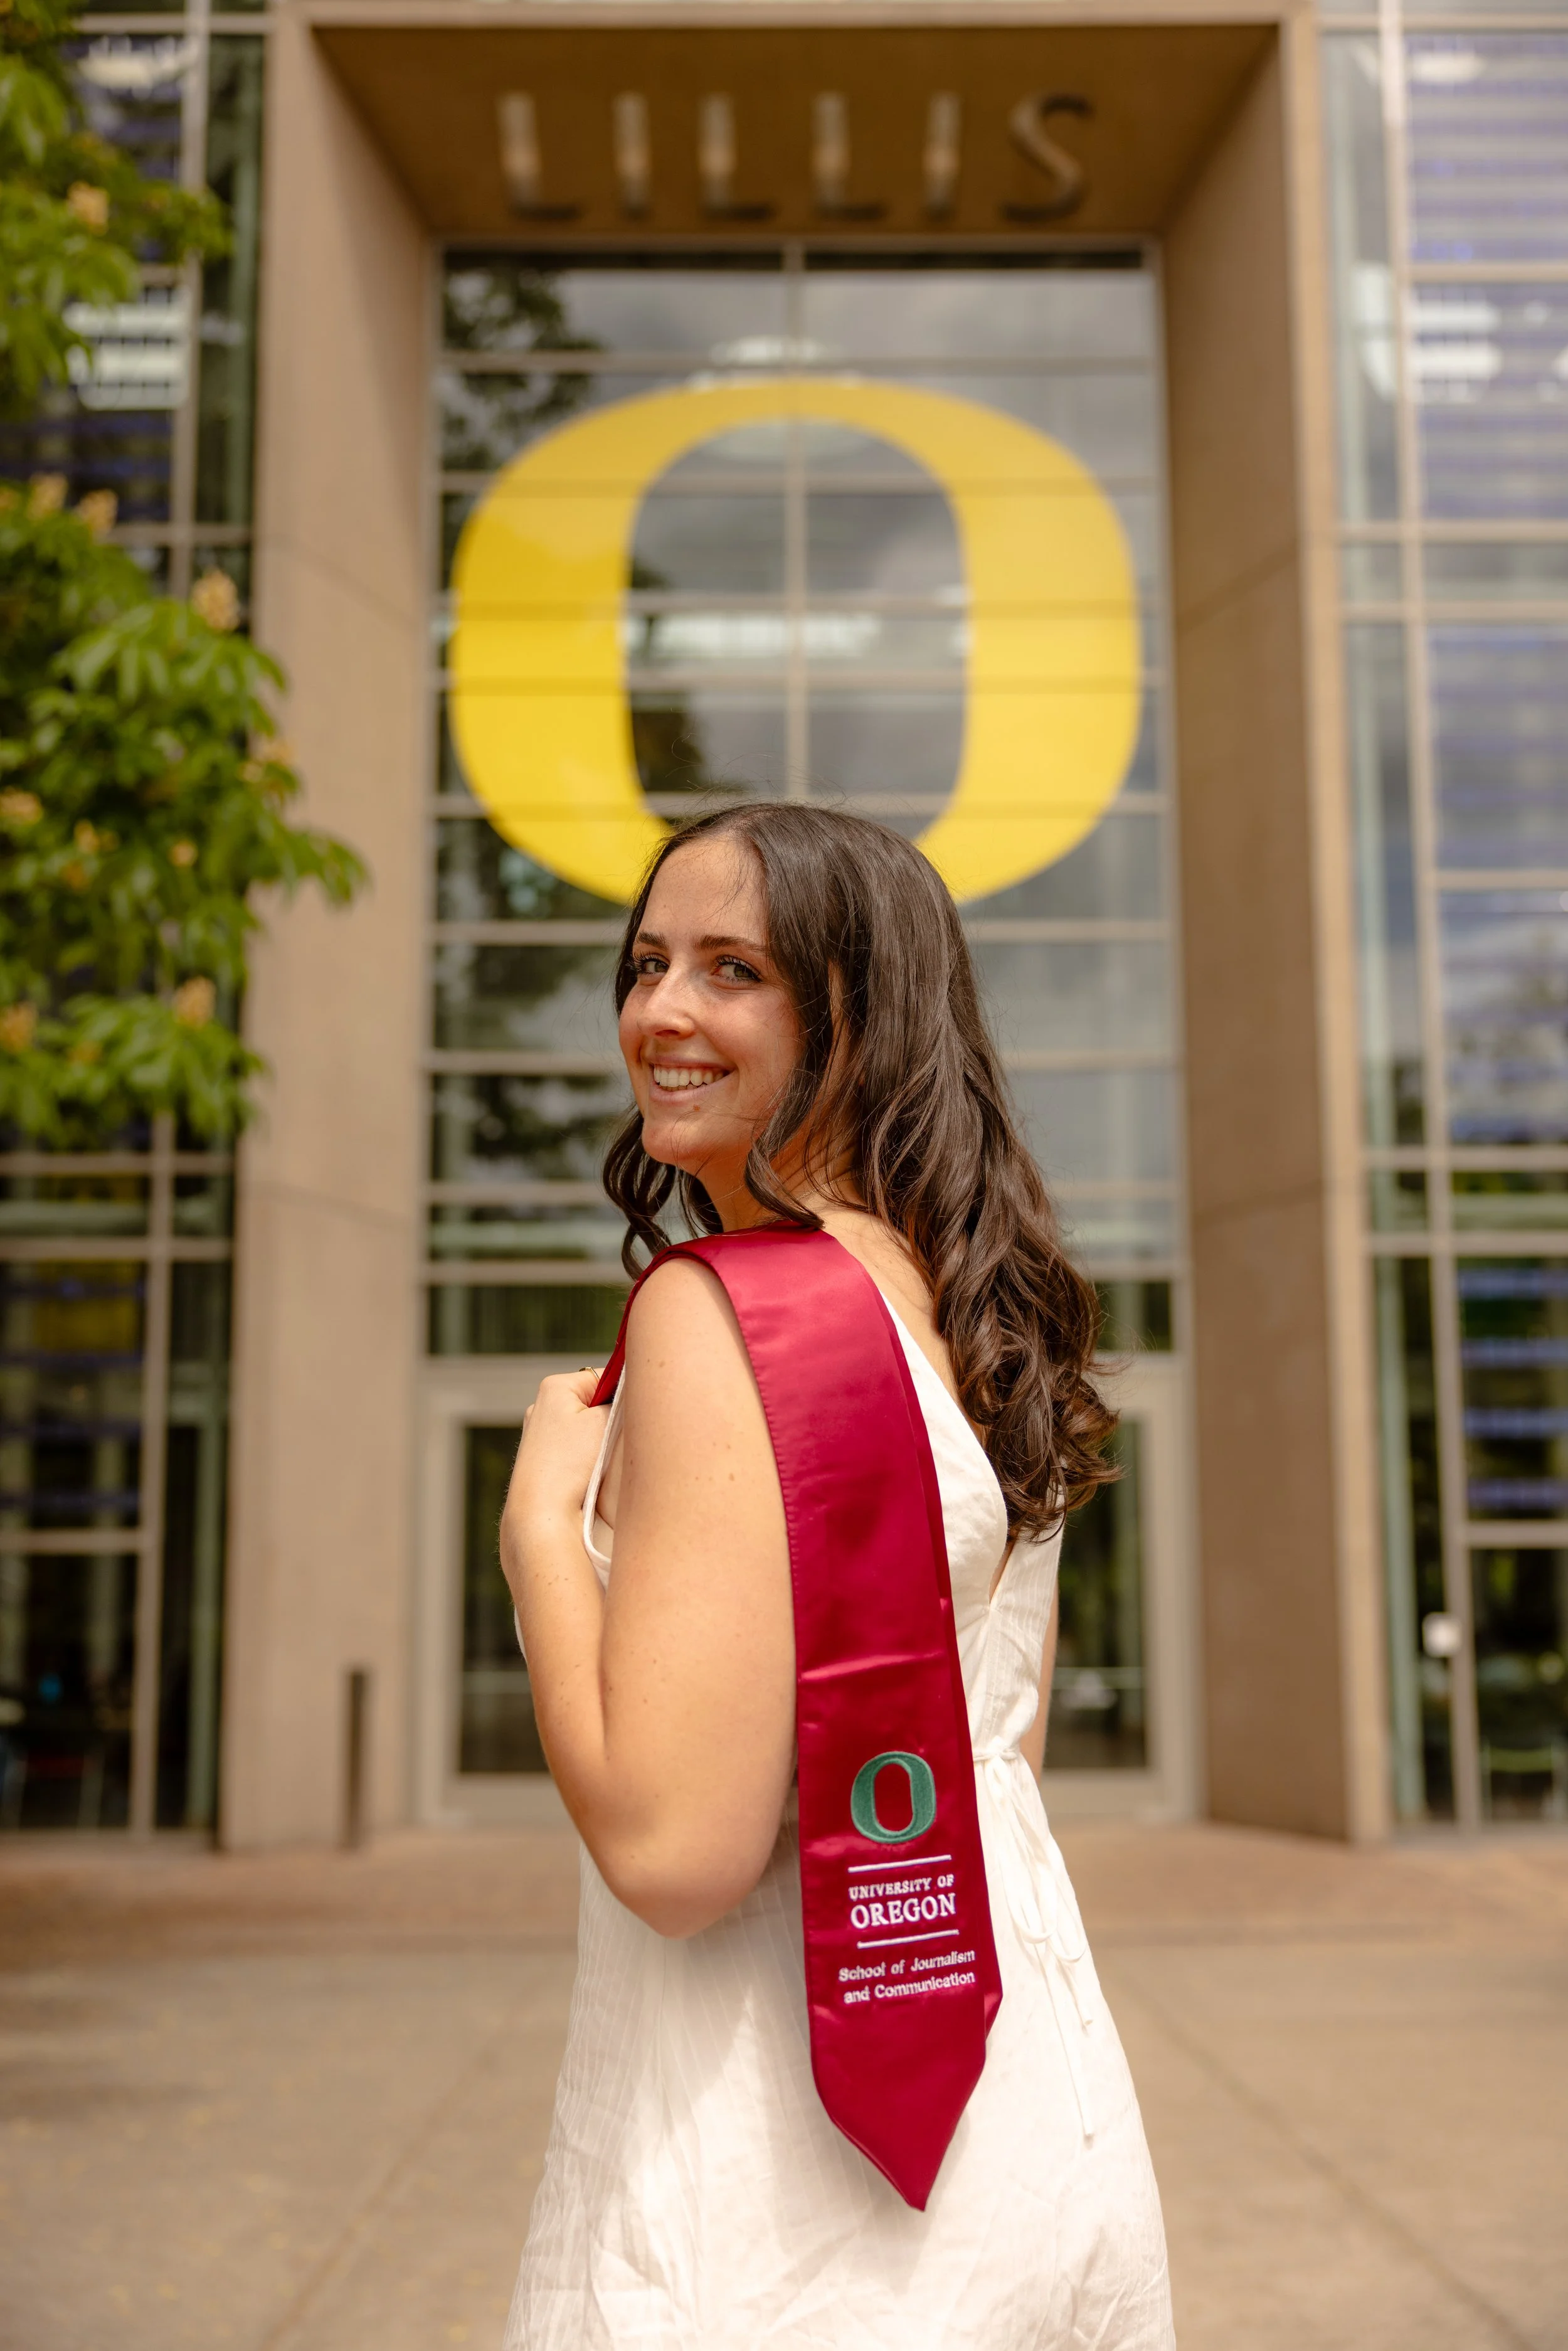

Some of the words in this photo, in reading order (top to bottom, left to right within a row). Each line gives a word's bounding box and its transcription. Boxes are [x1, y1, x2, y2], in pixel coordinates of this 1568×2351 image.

[499, 91, 1093, 221] LILLIS
[850, 1751, 936, 1844] O
[849, 1877, 931, 1900] UNIVERSITY
[937, 1874, 954, 1887] OF
[850, 1893, 956, 1929] OREGON
[839, 1961, 886, 1982] School
[891, 1959, 905, 1974] of
[911, 1950, 975, 1972] Journalism
[844, 1985, 871, 2004] and
[874, 1972, 975, 1998] Communication
